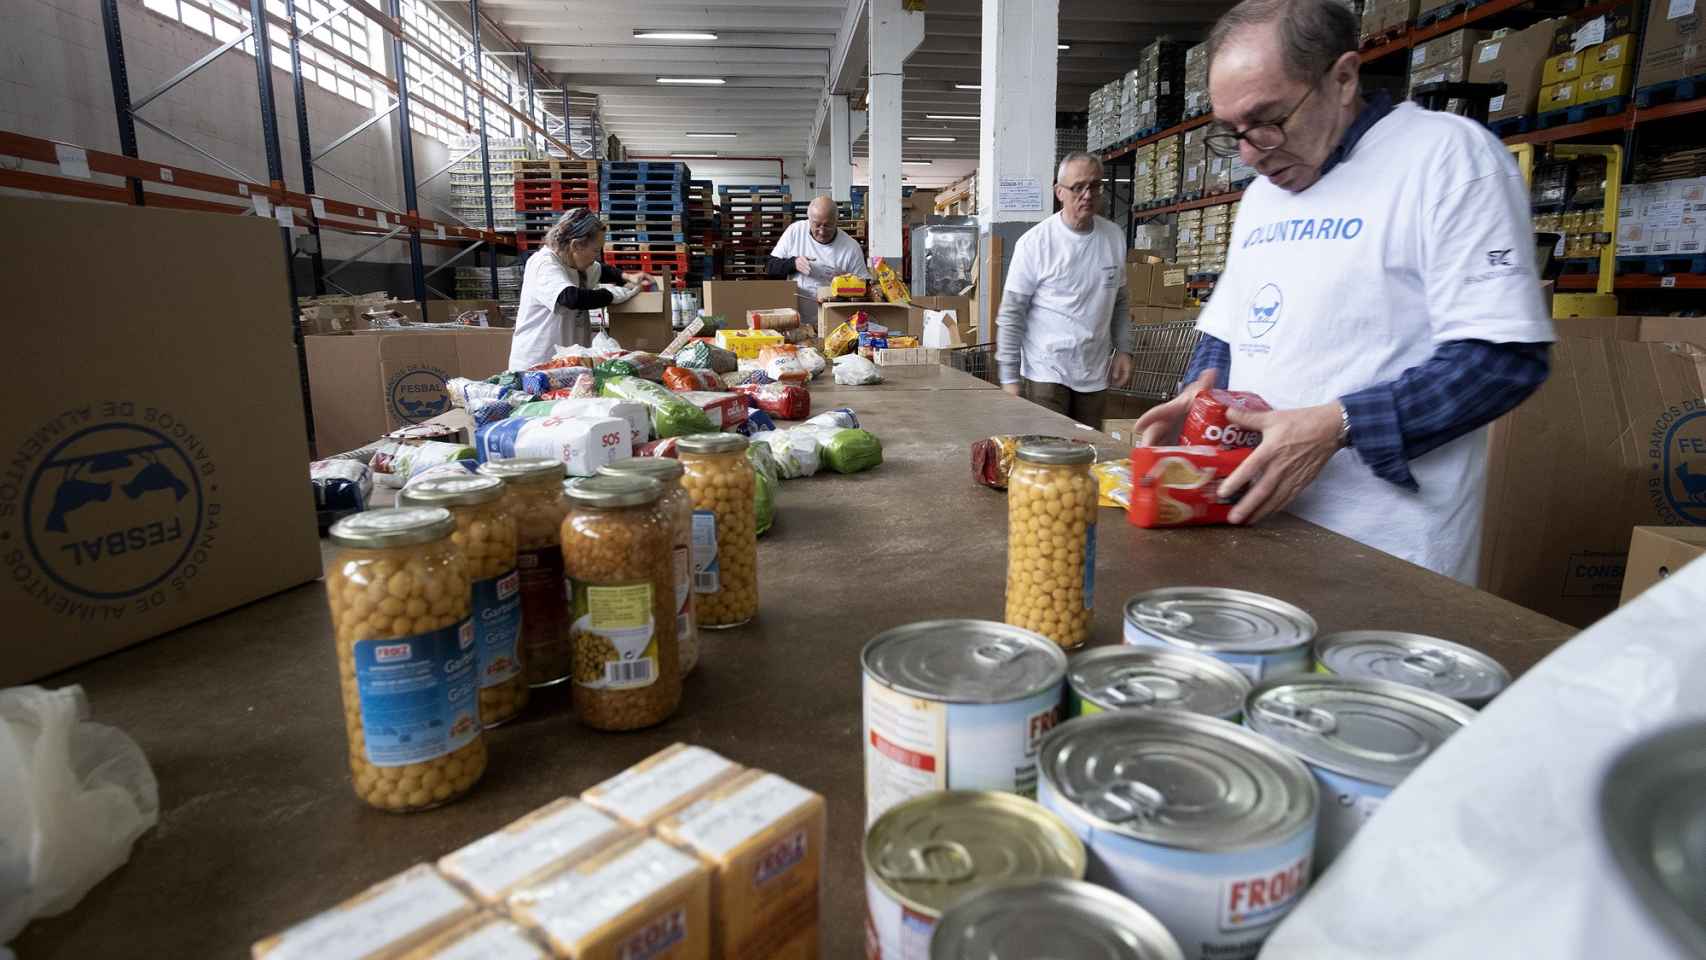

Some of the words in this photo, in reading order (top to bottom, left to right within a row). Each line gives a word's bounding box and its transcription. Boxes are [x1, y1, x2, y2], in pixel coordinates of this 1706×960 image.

[400, 383, 443, 394] FESBAL
[103, 401, 134, 417] DE
[144, 407, 216, 476] BANCOS
[601, 431, 621, 447] SOS
[60, 516, 184, 566] FESBAL
[171, 503, 221, 592] BANCOS
[134, 590, 166, 615] DE
